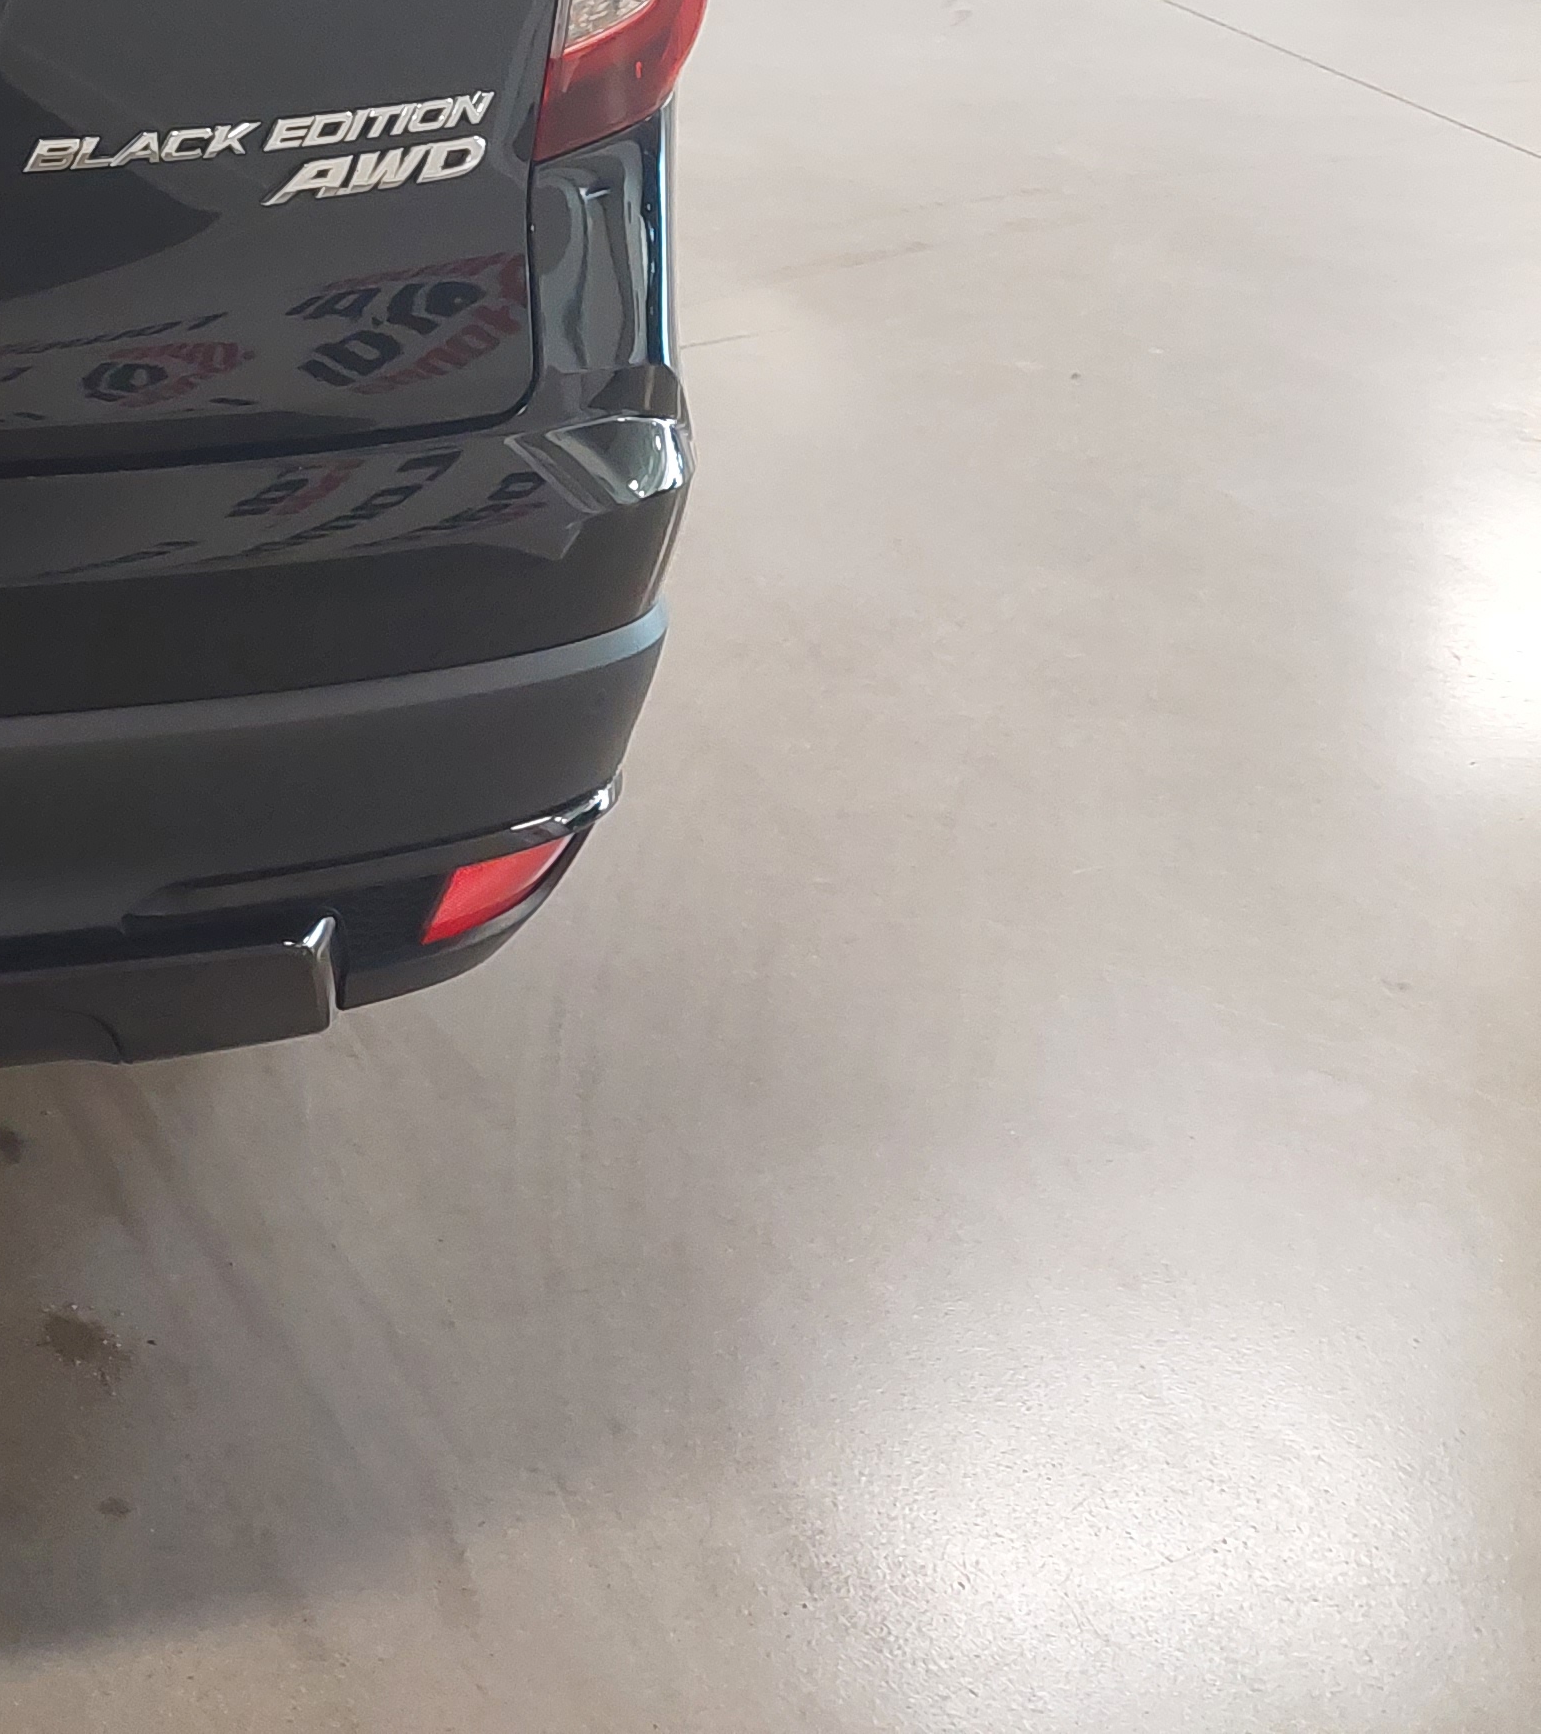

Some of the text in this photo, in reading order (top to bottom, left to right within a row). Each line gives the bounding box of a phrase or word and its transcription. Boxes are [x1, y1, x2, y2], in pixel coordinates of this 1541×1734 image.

[22, 121, 261, 173] BLACK
[263, 91, 495, 151] EDITION
[260, 135, 487, 206] AWD
